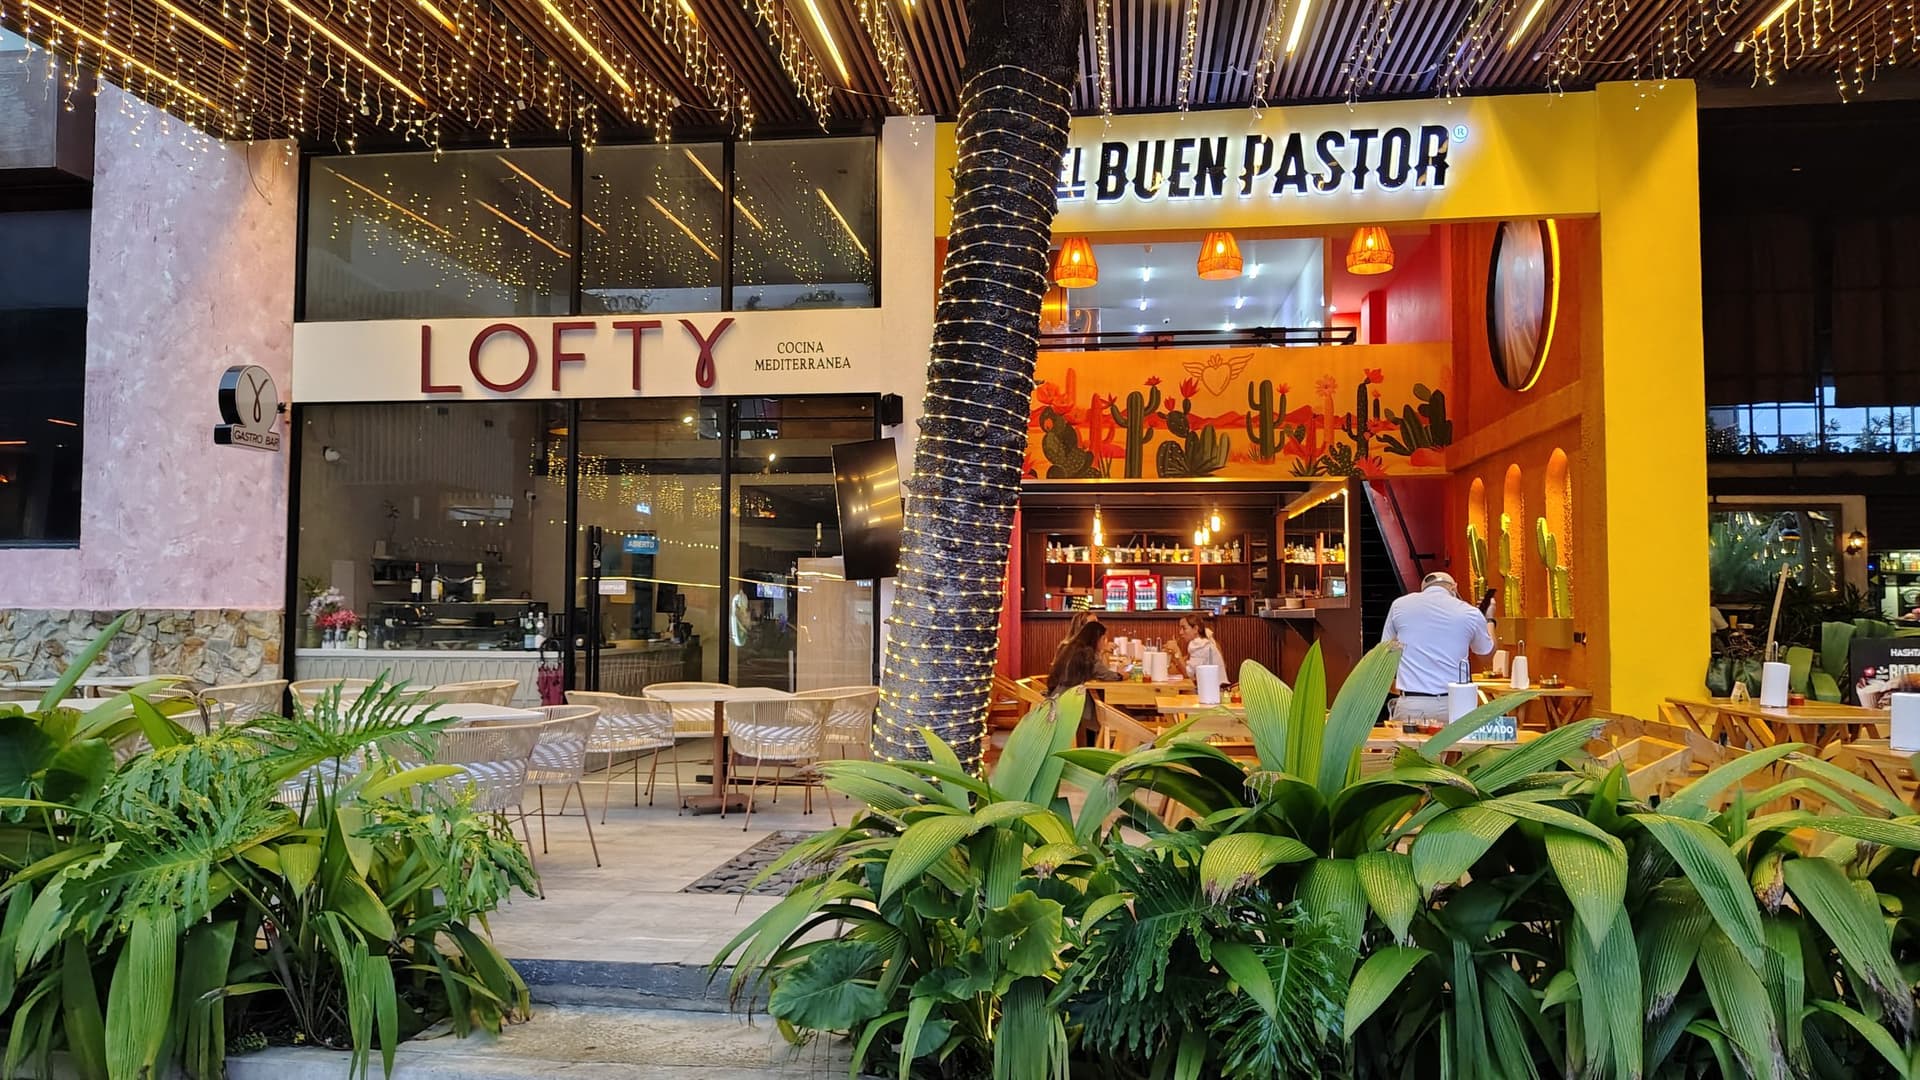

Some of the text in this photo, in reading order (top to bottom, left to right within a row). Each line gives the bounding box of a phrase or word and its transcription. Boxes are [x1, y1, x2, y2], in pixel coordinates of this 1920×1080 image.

[1096, 136, 1228, 202] BUEN
[1238, 124, 1450, 198] PASTOR
[421, 317, 736, 394] LOFTY
[777, 341, 825, 354] COCINA
[754, 356, 851, 371] MEDITERRANEA
[234, 430, 280, 447] GASTRO BAR
